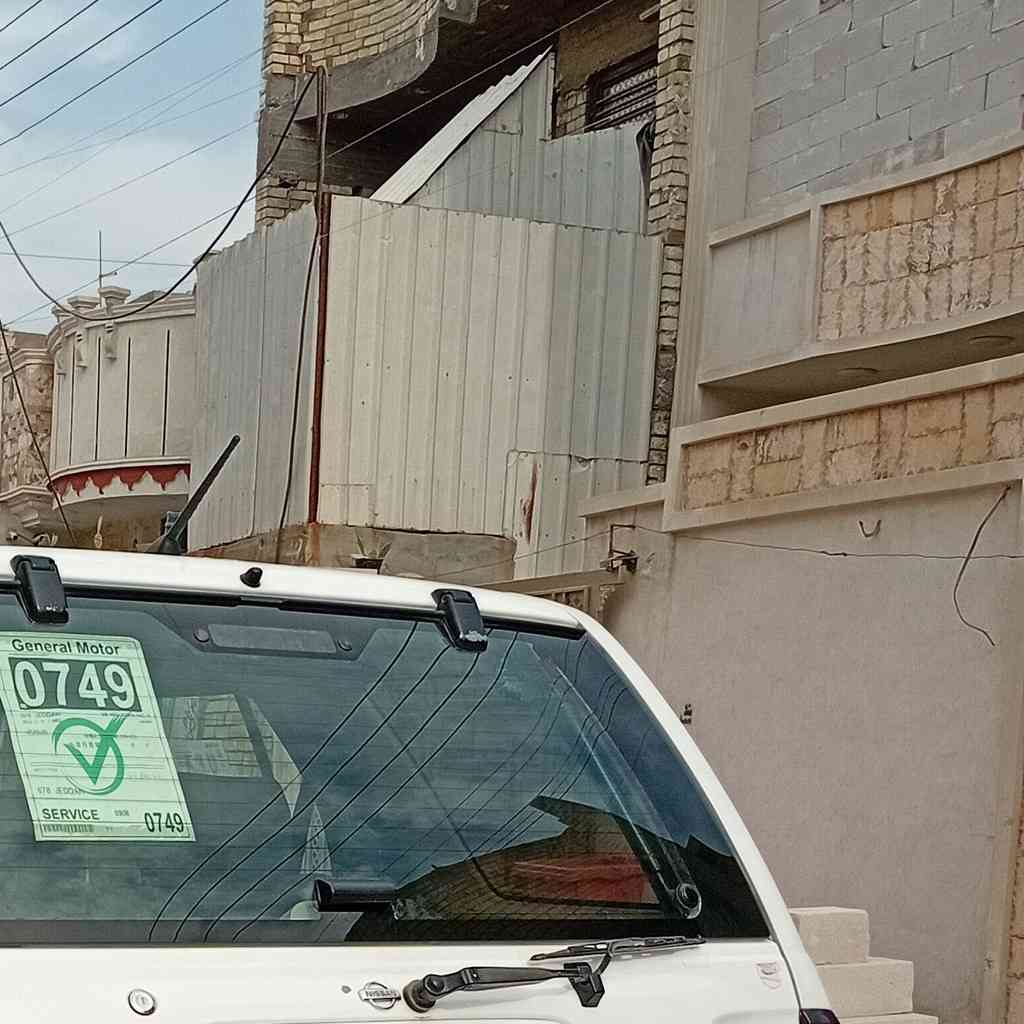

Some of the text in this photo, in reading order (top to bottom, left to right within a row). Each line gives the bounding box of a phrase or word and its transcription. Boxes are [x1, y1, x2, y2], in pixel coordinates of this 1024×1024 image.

[11, 639, 119, 655] General Motor
[14, 661, 135, 709] 0749
[41, 808, 100, 820] SERVICE
[144, 812, 184, 833] 0749
